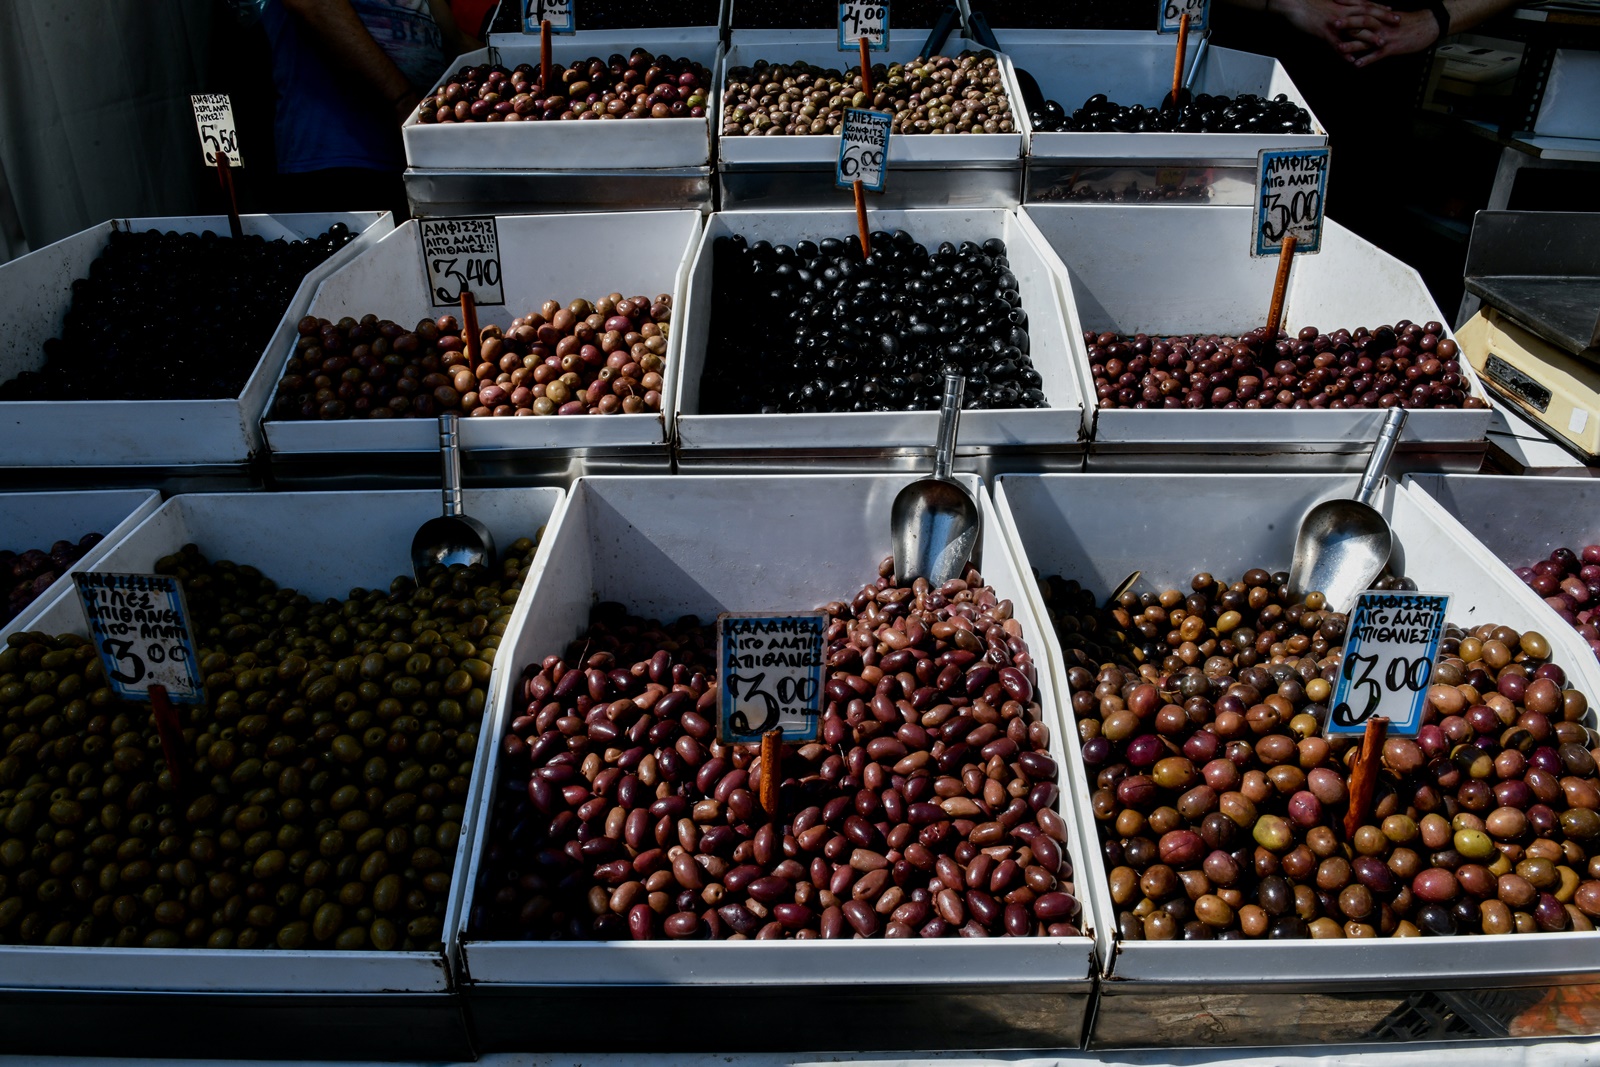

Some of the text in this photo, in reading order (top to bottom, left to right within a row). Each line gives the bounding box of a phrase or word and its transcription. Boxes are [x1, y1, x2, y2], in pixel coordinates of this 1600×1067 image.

[842, 6, 886, 34] 4.00
[846, 111, 872, 124] ΕΛΙΕΣ
[843, 133, 886, 147] ΑΝΑΛΑΤΕΣ
[1262, 174, 1319, 188] ΛΙΓΟ ΑΛΑΤΙ
[424, 221, 492, 236] ΑΜΦΙΣΣΗΣ
[426, 237, 449, 247] ΛΙΓΟ
[77, 573, 176, 592] ΑΜΦΙΣΣΗΣ
[83, 589, 154, 609] ΨΙΛΕΣ
[1357, 595, 1444, 611] ΑΜΦΙΣΣΗΣ
[87, 605, 184, 626] ΑΠΙΘΑΝΕΣ
[1354, 610, 1389, 626] ΛΙΓΟ
[725, 619, 824, 636] ΚΑΛΑΜΩΝ
[1350, 626, 1440, 644] ΑΠΙΘΑΝΕΣ!!
[727, 638, 763, 650] ΛΙΓΟ
[102, 638, 190, 685] 3.00
